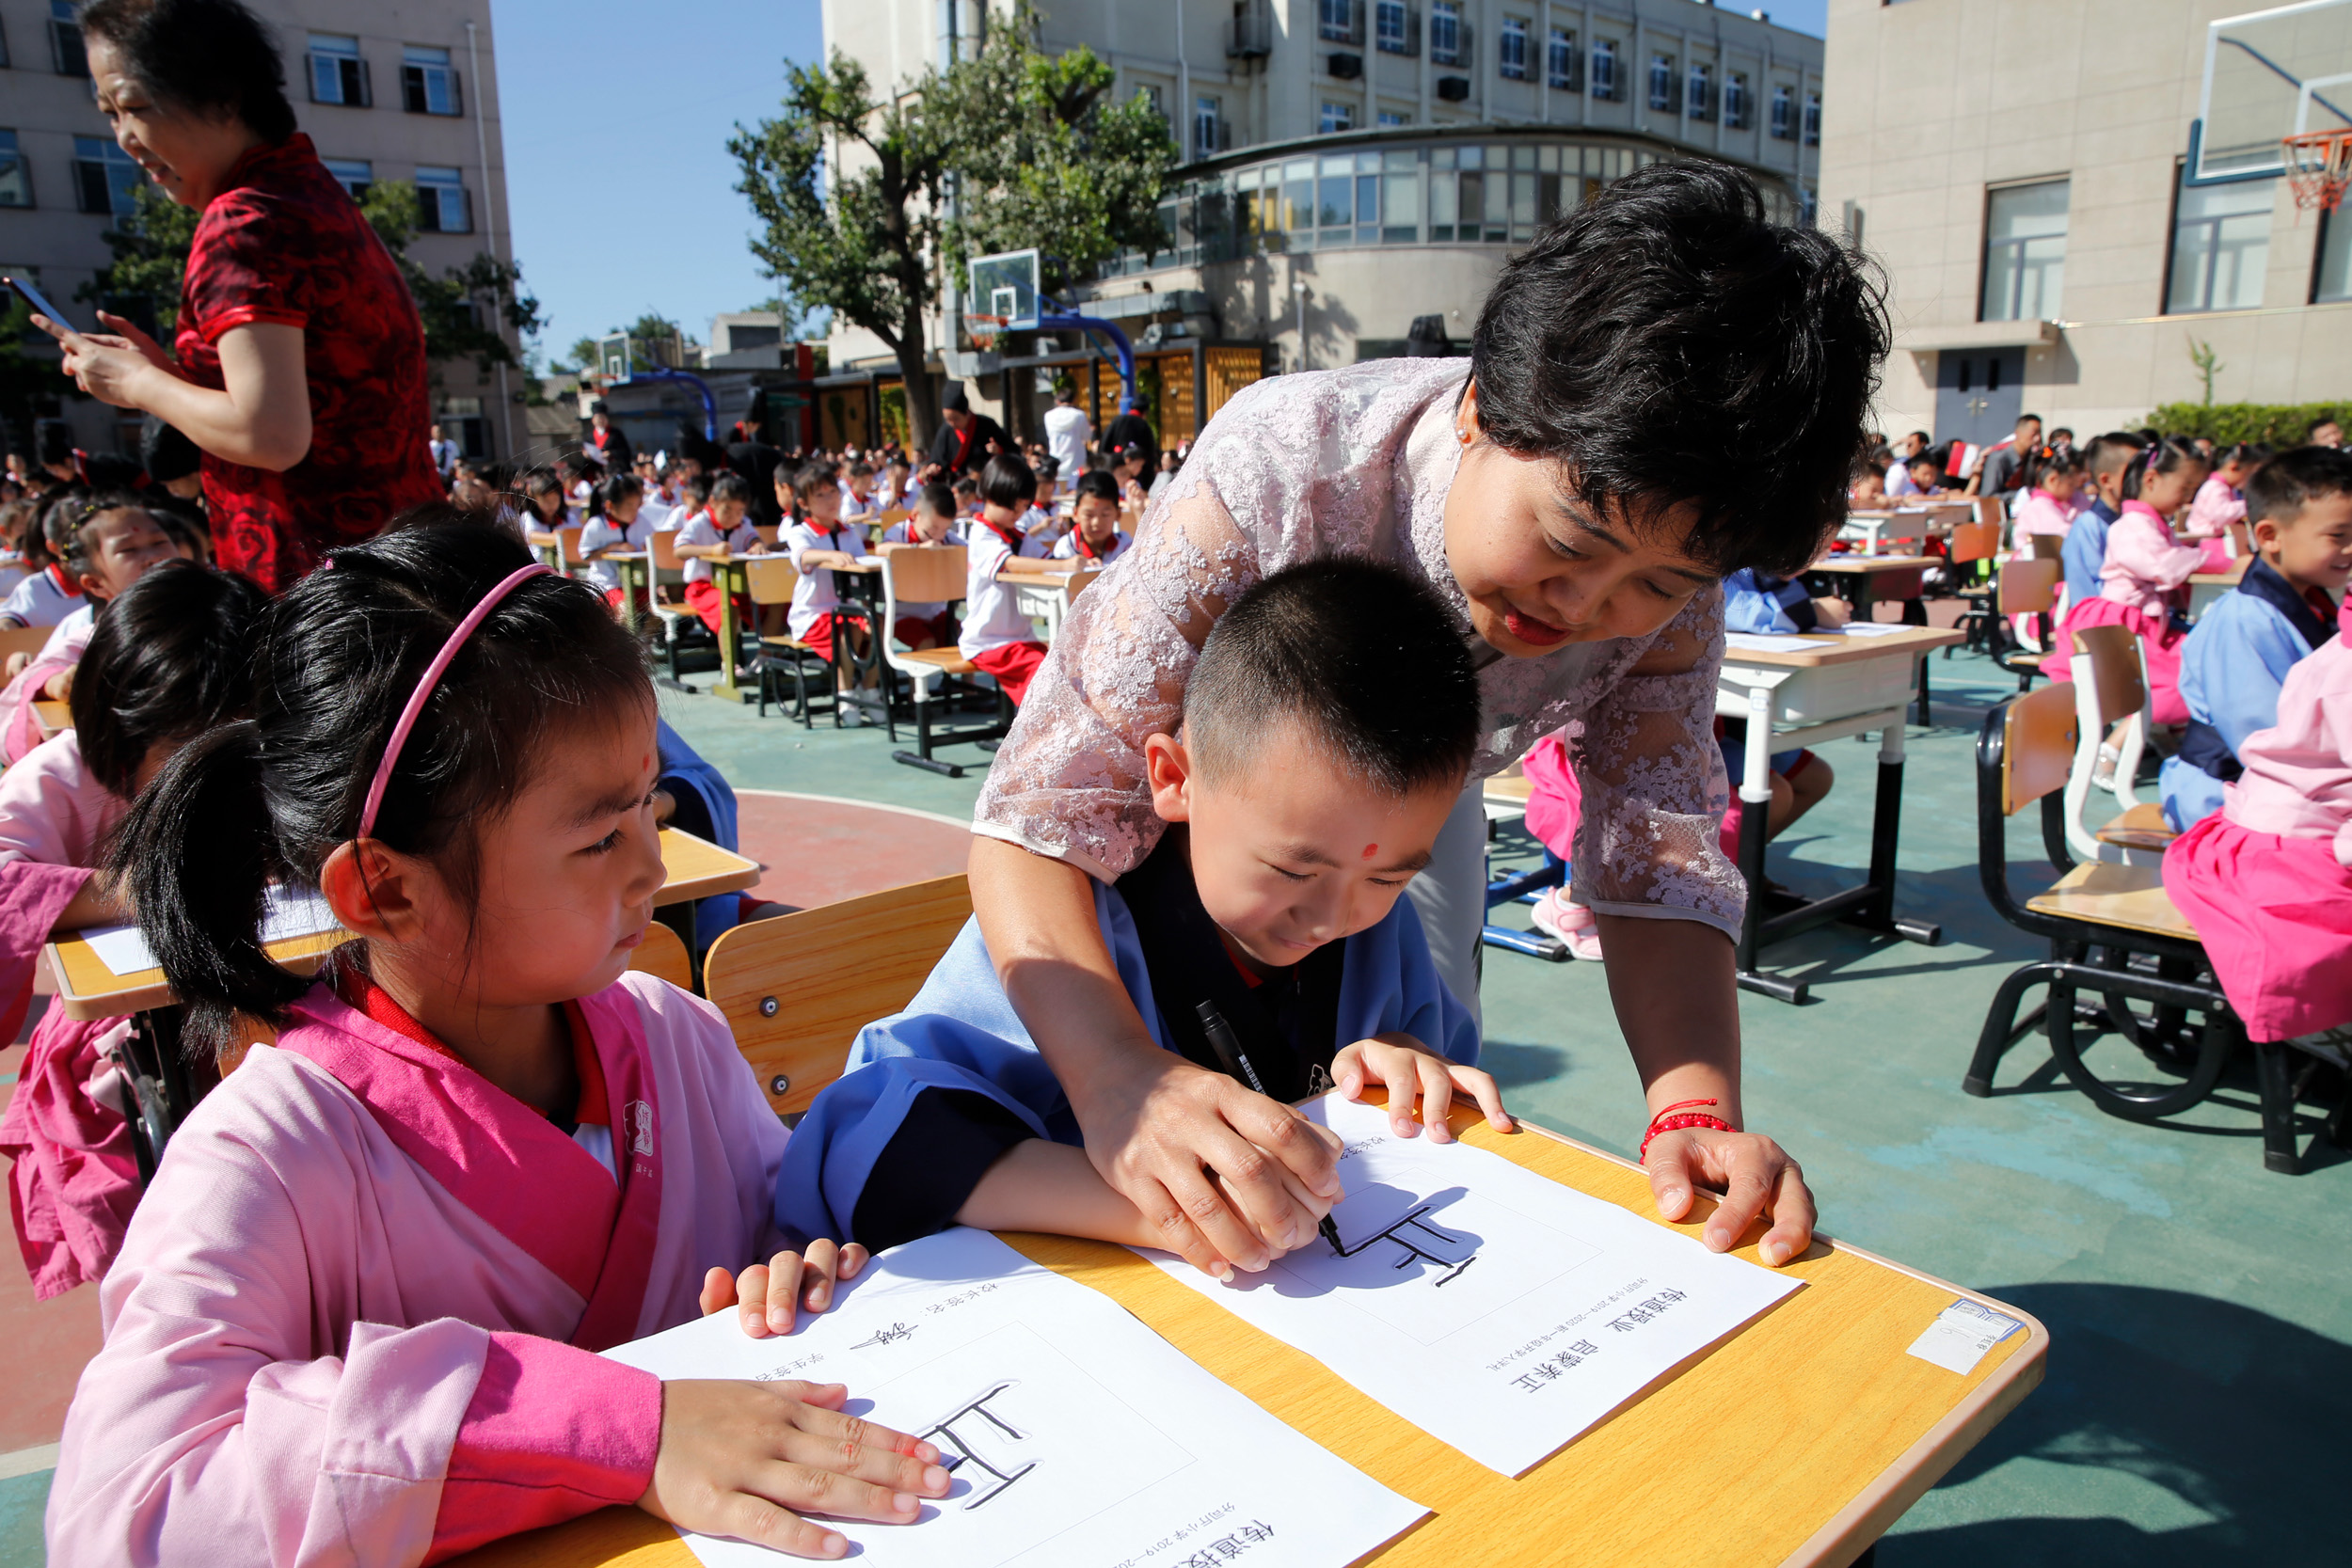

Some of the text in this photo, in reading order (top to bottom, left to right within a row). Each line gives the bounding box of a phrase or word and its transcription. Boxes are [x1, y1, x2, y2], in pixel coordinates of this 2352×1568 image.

[1508, 1287, 1688, 1394] 传道授业 启蒙养正
[1170, 1518, 1275, 1568] 传道授
[1172, 1501, 1236, 1542] 分司厅小学
